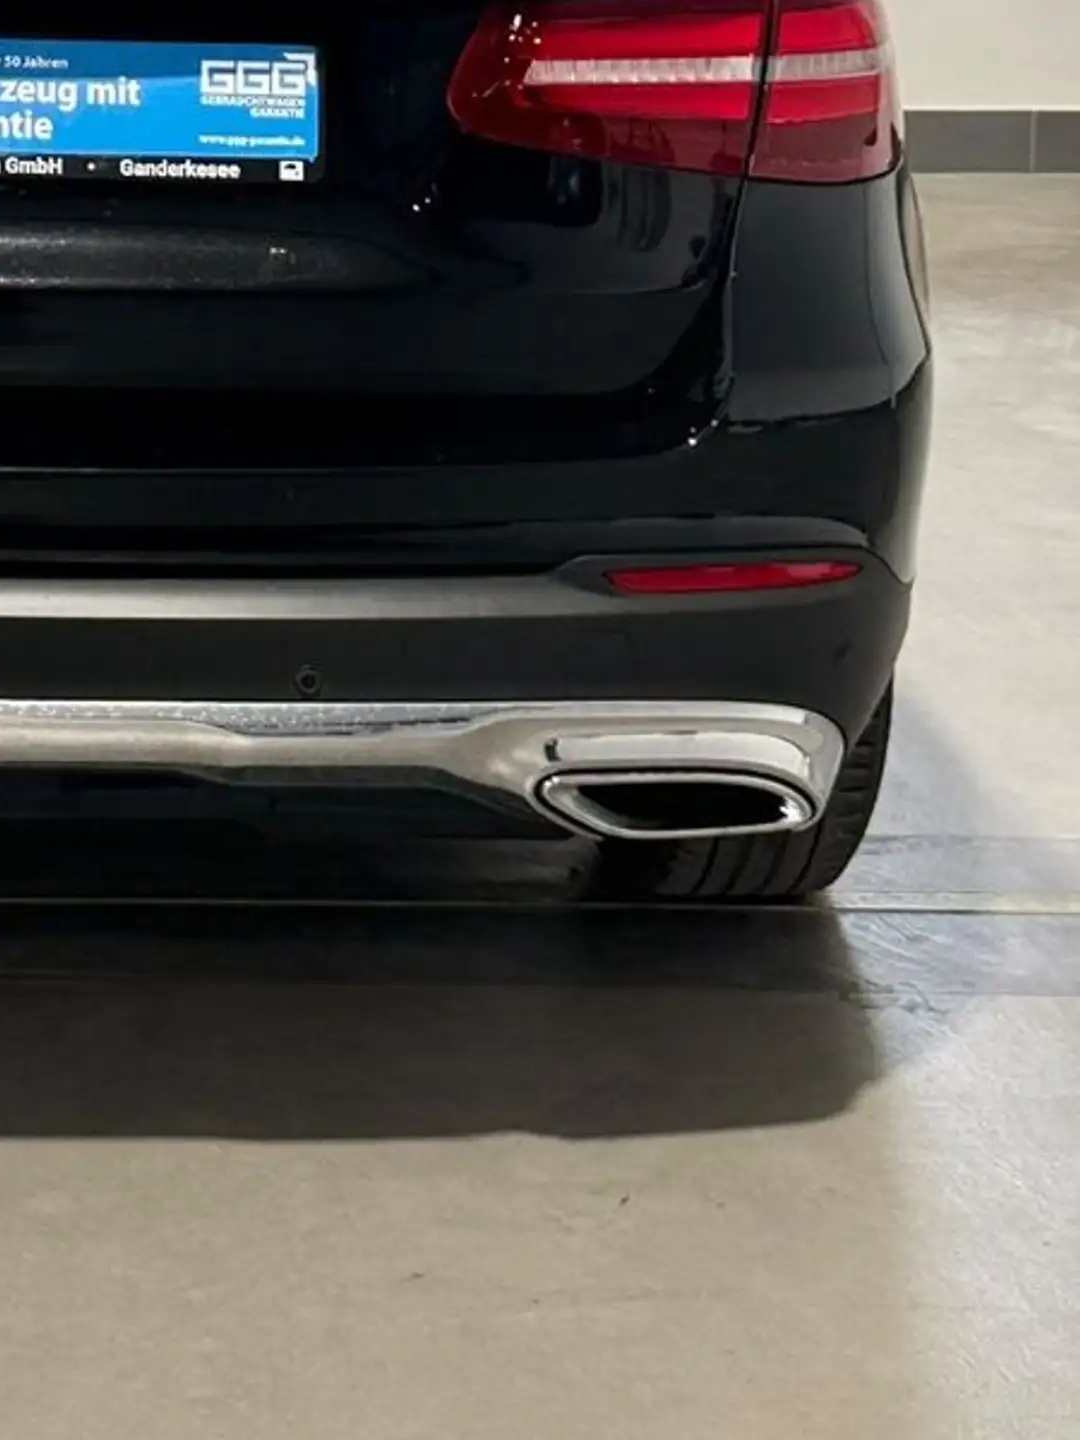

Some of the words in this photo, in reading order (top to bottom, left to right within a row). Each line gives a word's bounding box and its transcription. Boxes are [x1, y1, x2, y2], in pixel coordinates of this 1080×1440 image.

[86, 76, 142, 107] mit
[201, 59, 306, 96] GGG
[5, 155, 64, 175] GmbH
[119, 158, 241, 179] Ganderkesee
